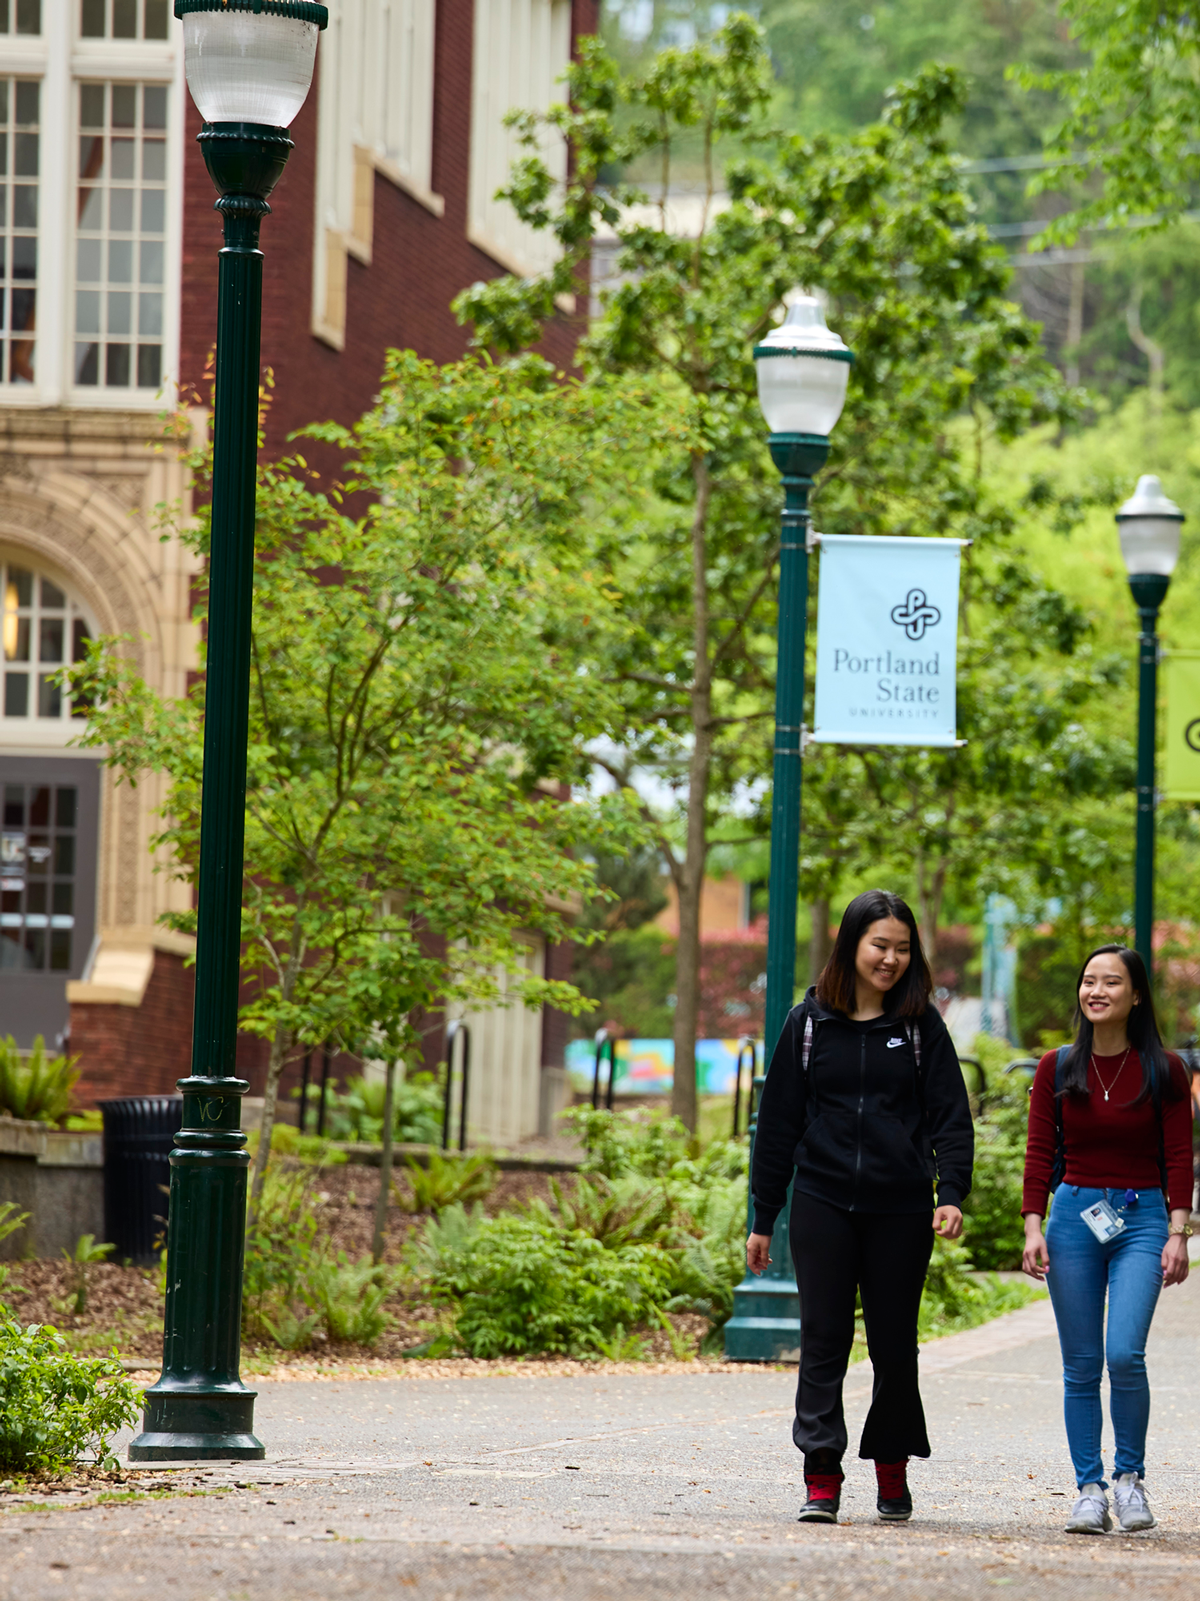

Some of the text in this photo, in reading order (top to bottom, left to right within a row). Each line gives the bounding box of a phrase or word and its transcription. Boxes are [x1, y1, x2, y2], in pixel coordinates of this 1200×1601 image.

[834, 649, 940, 675] Portland
[877, 678, 940, 704] State
[849, 708, 939, 718] UNIVERSITY
